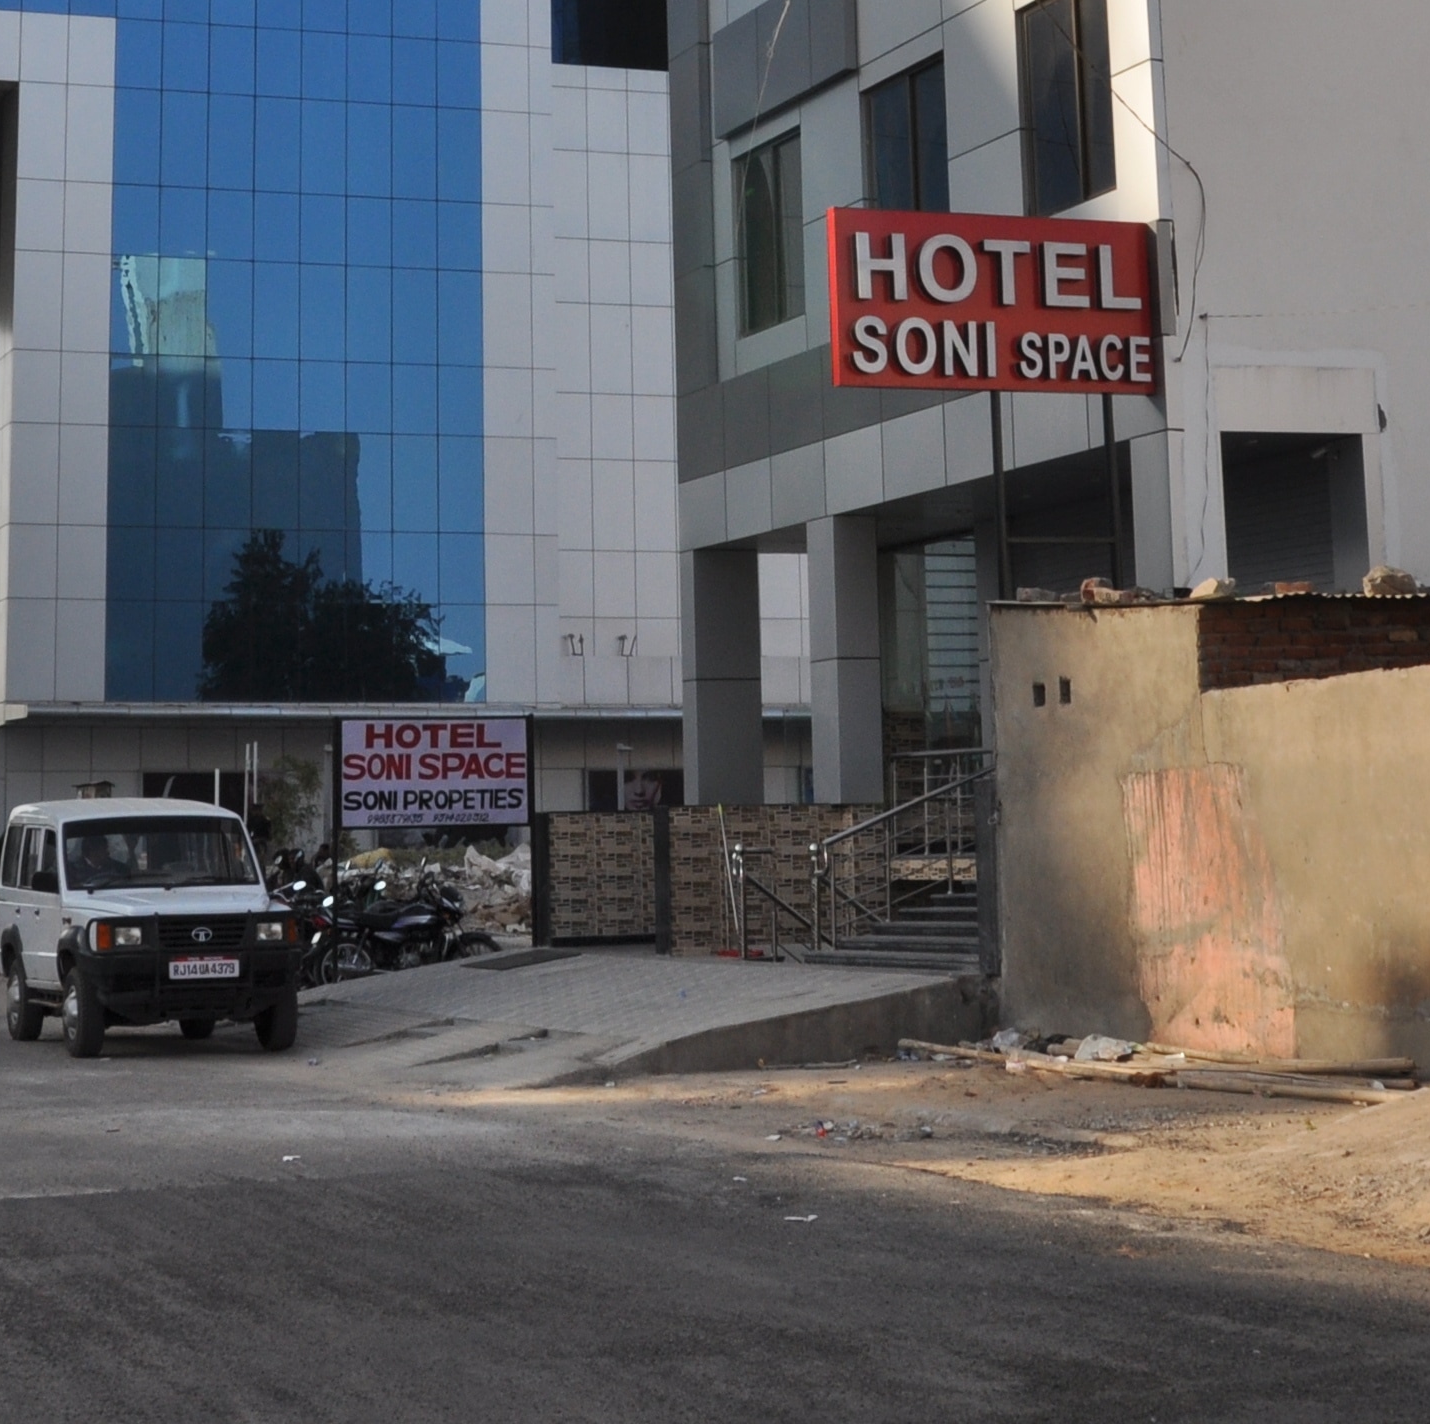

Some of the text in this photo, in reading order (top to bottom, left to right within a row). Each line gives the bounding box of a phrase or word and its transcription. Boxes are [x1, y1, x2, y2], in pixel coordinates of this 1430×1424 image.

[855, 231, 1142, 310] HOTEL
[851, 315, 1152, 382] SONI SPACE
[365, 723, 502, 749] HOTEL
[343, 752, 526, 781] SONI SPACE
[343, 788, 524, 811] SONI PROPETIES
